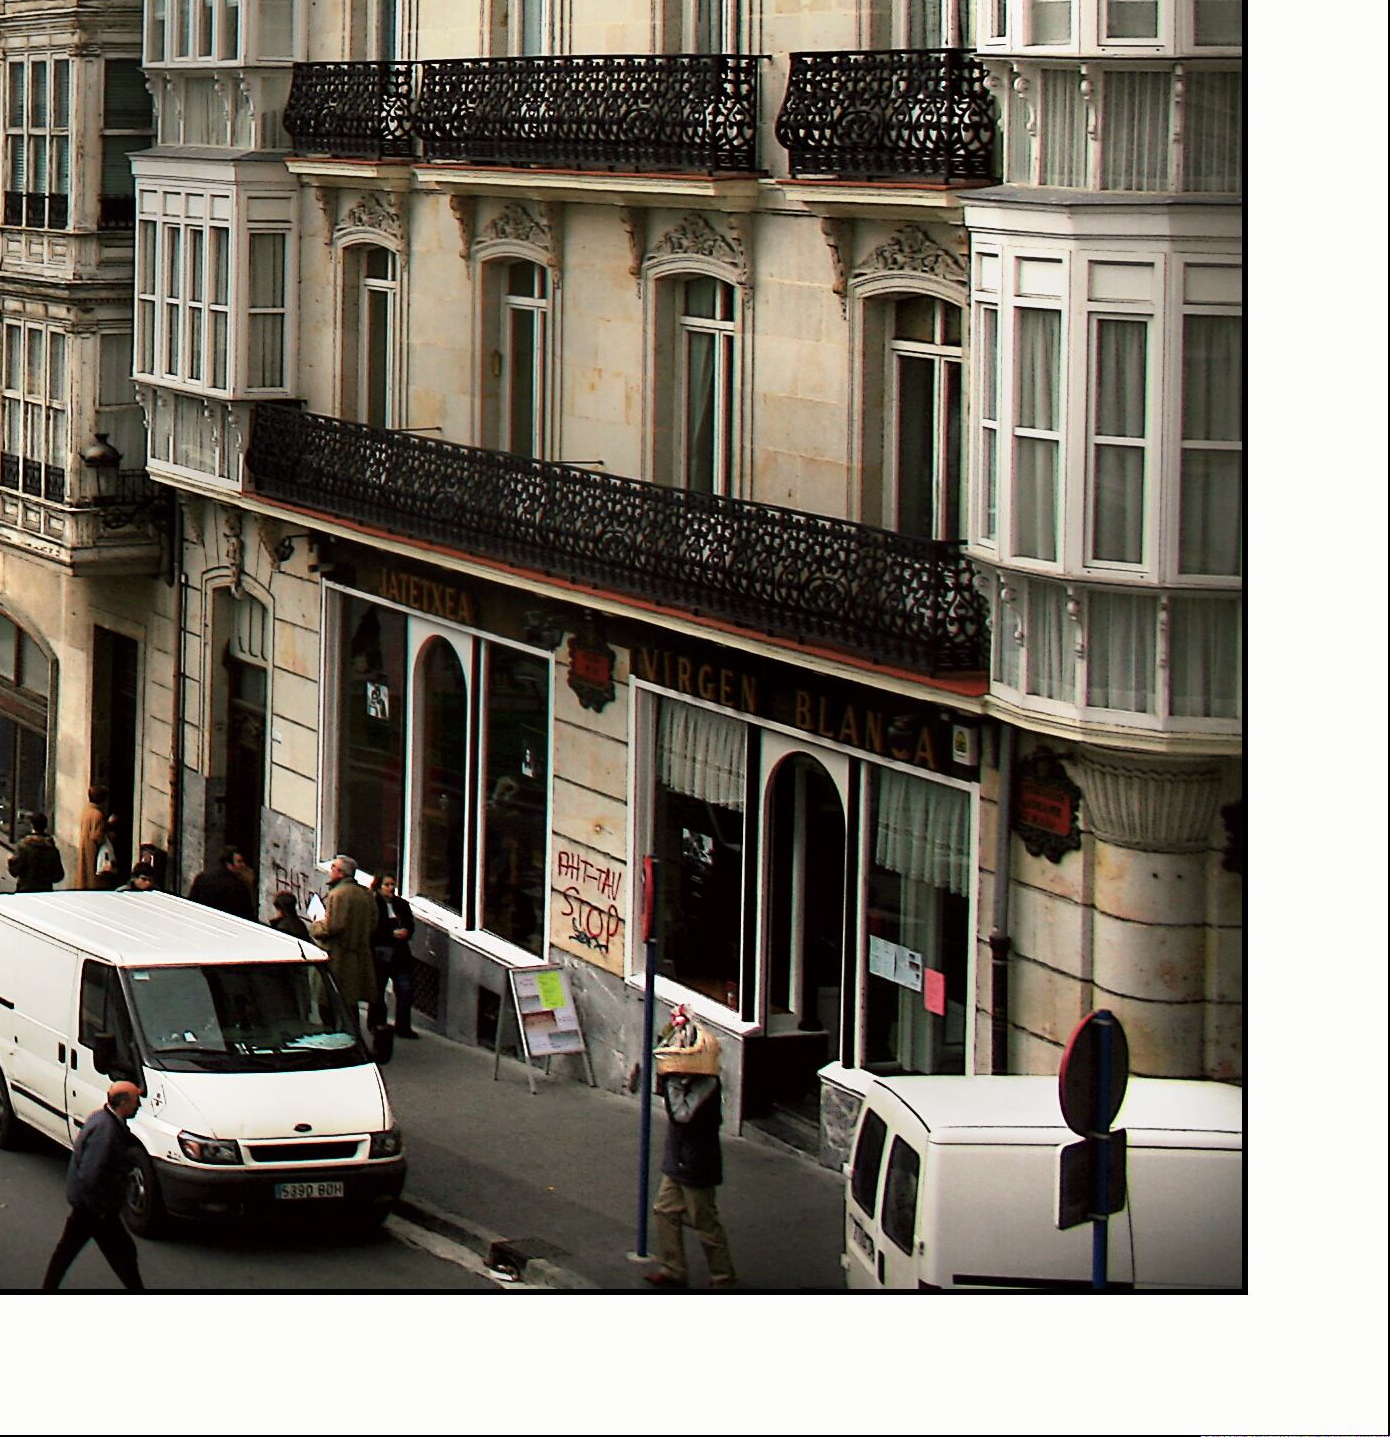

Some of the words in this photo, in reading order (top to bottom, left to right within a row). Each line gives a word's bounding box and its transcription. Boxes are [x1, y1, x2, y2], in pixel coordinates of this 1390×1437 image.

[379, 566, 473, 624] JATETXEA
[641, 647, 758, 714] VIRGEN
[561, 885, 620, 954] STOP
